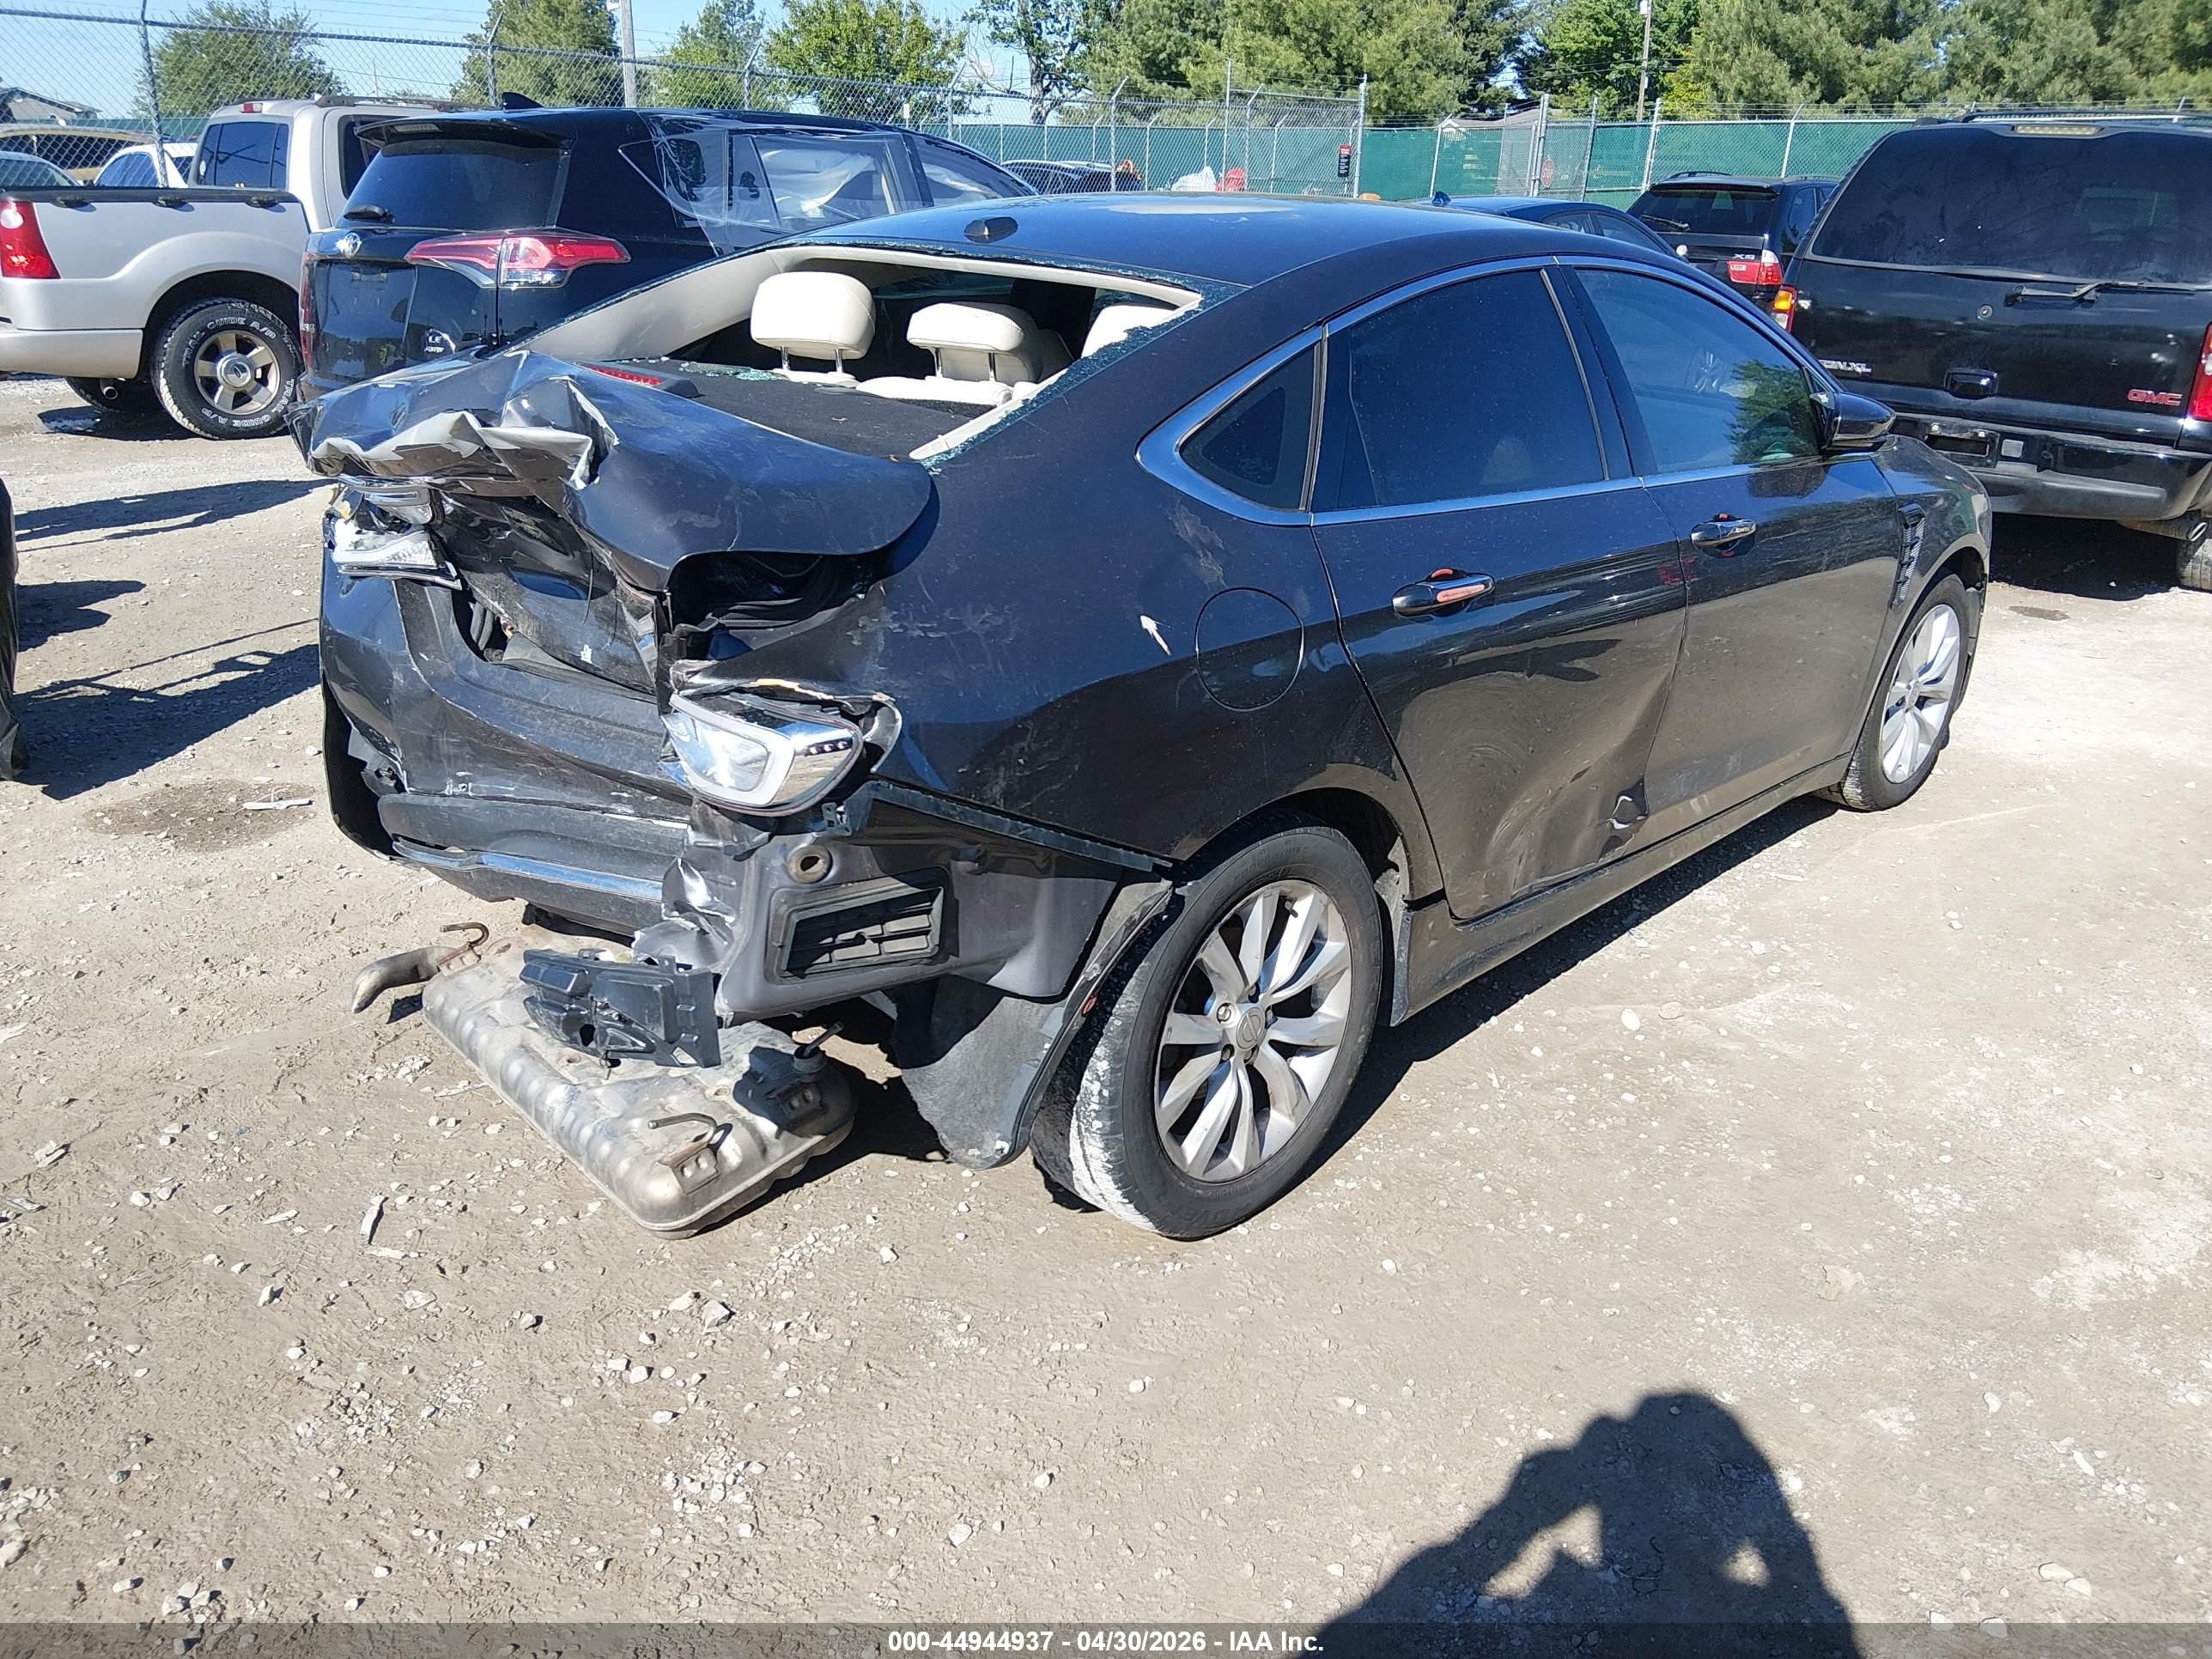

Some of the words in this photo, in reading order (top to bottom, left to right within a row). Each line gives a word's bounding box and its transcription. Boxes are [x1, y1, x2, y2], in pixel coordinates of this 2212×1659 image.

[182, 331, 205, 366] TRAIL
[207, 316, 246, 330] GUIDE
[428, 335, 442, 343] LE
[271, 379, 295, 414] TRAIL
[2128, 389, 2183, 406] GMC
[233, 414, 271, 428] GUIDE
